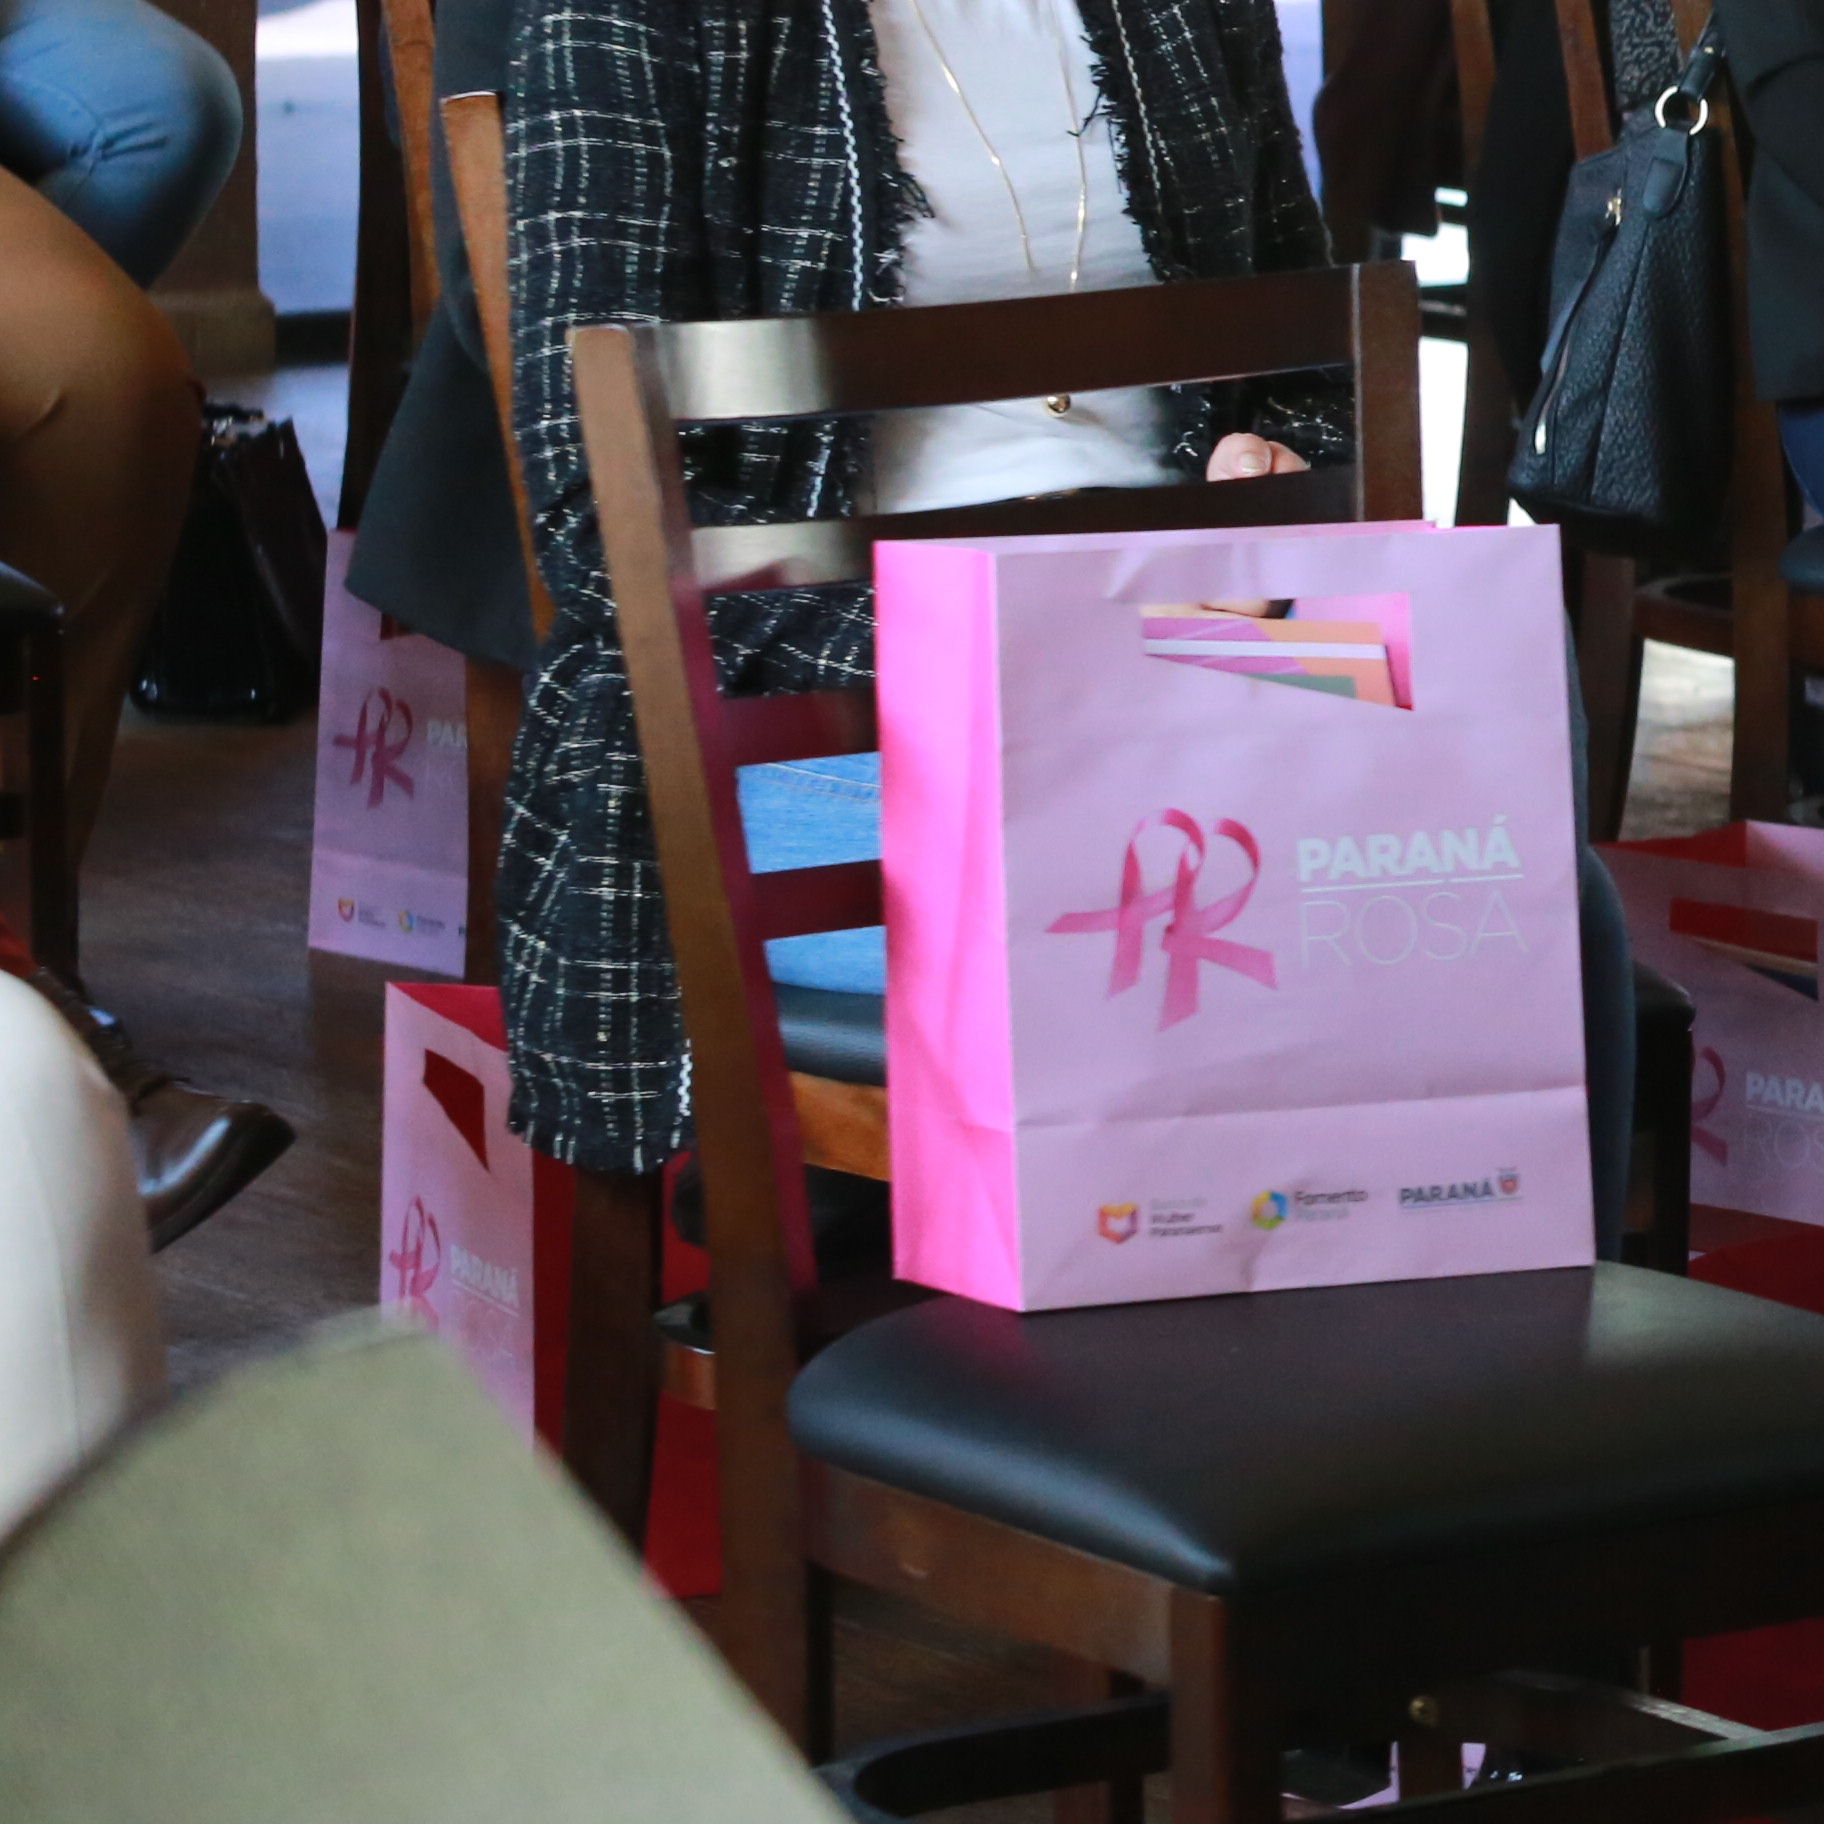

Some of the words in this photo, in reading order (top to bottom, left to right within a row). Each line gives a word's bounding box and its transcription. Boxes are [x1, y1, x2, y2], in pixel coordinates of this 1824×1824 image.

[1297, 813, 1524, 882] PARANÁ
[1301, 890, 1529, 967] ROSA
[450, 1242, 520, 1310] PARANÁ
